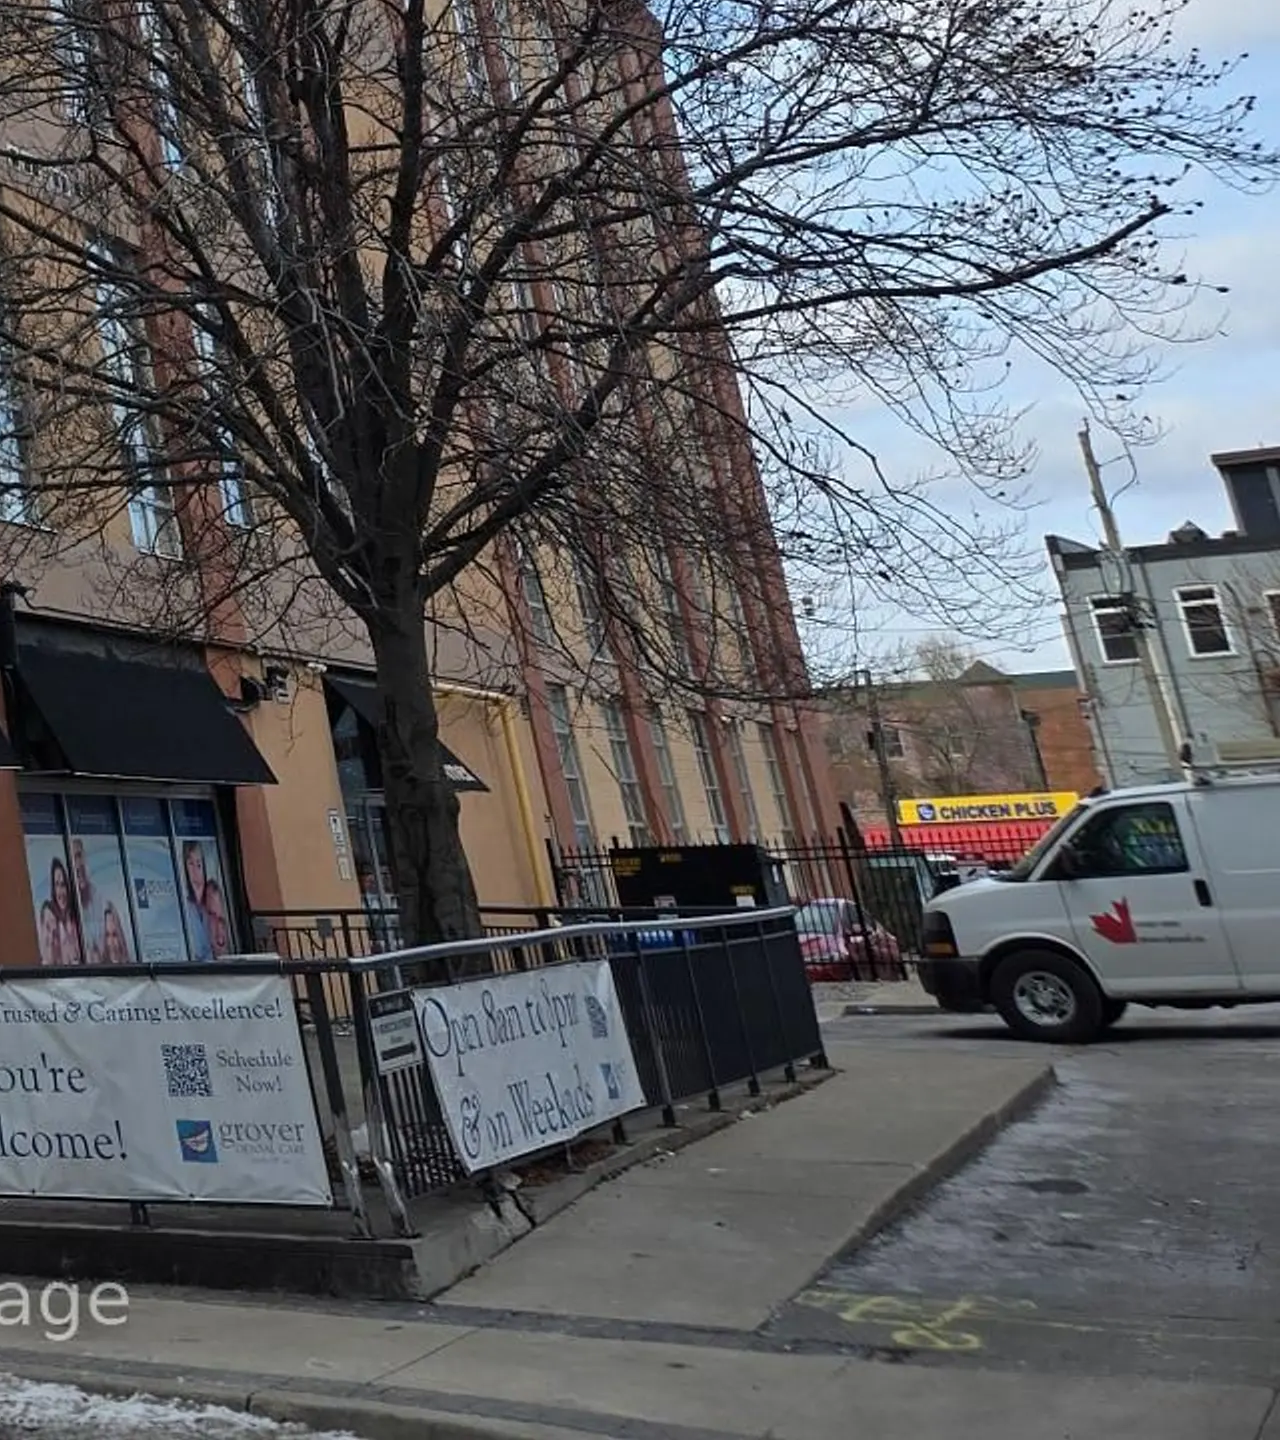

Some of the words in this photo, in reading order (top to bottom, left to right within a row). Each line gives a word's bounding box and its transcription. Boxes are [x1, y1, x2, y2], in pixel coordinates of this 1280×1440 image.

[940, 803, 1010, 820] CHICKEN
[1013, 800, 1058, 818] PLUS
[62, 1001, 82, 1024] &
[87, 1000, 162, 1025] Caring
[164, 997, 283, 1021] Excellence!
[215, 1048, 293, 1069] Schedule
[236, 1075, 284, 1093] Now!
[218, 1120, 306, 1149] grover
[459, 1091, 482, 1160] &
[485, 1108, 514, 1153] on
